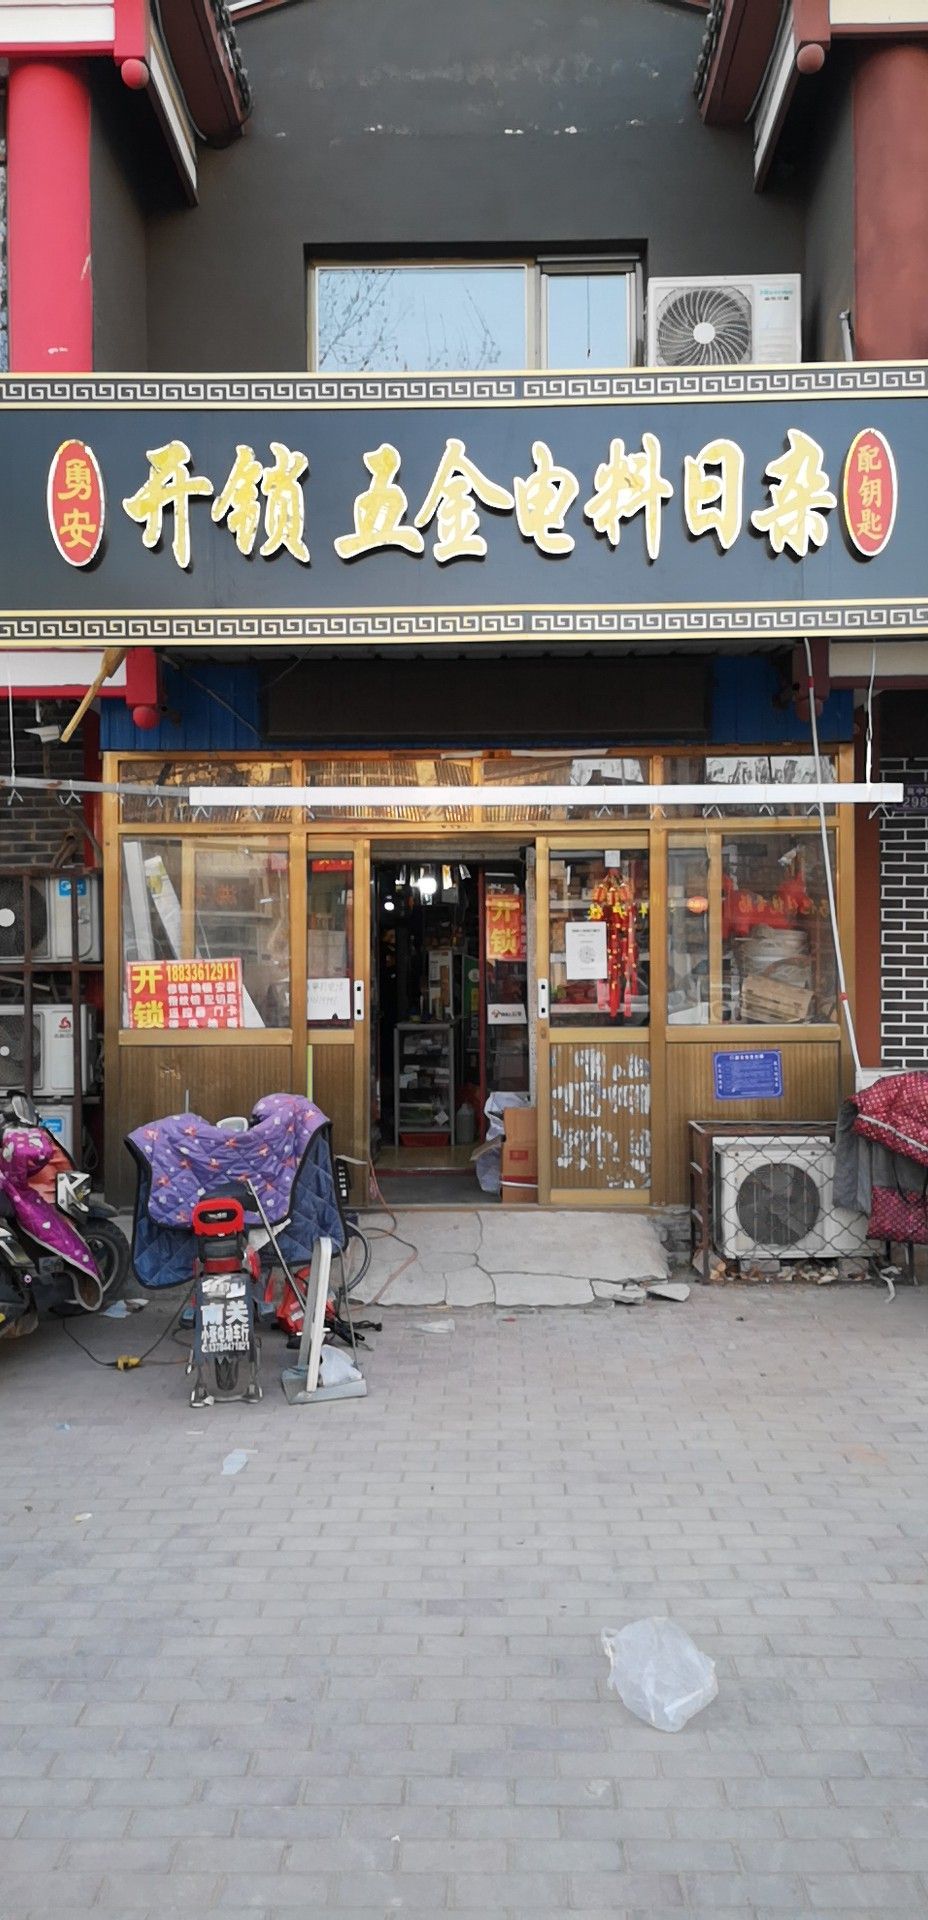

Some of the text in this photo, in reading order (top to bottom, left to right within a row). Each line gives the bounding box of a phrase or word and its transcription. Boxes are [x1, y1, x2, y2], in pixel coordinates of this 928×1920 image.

[57, 458, 97, 548] 勇安
[121, 427, 838, 569] 开锁 五金电料日杂
[856, 444, 883, 540] 配钥匙
[490, 898, 520, 957] 开锁
[131, 965, 165, 1029] 开锁
[166, 962, 236, 982] 18833612911
[200, 1300, 249, 1326] 南关
